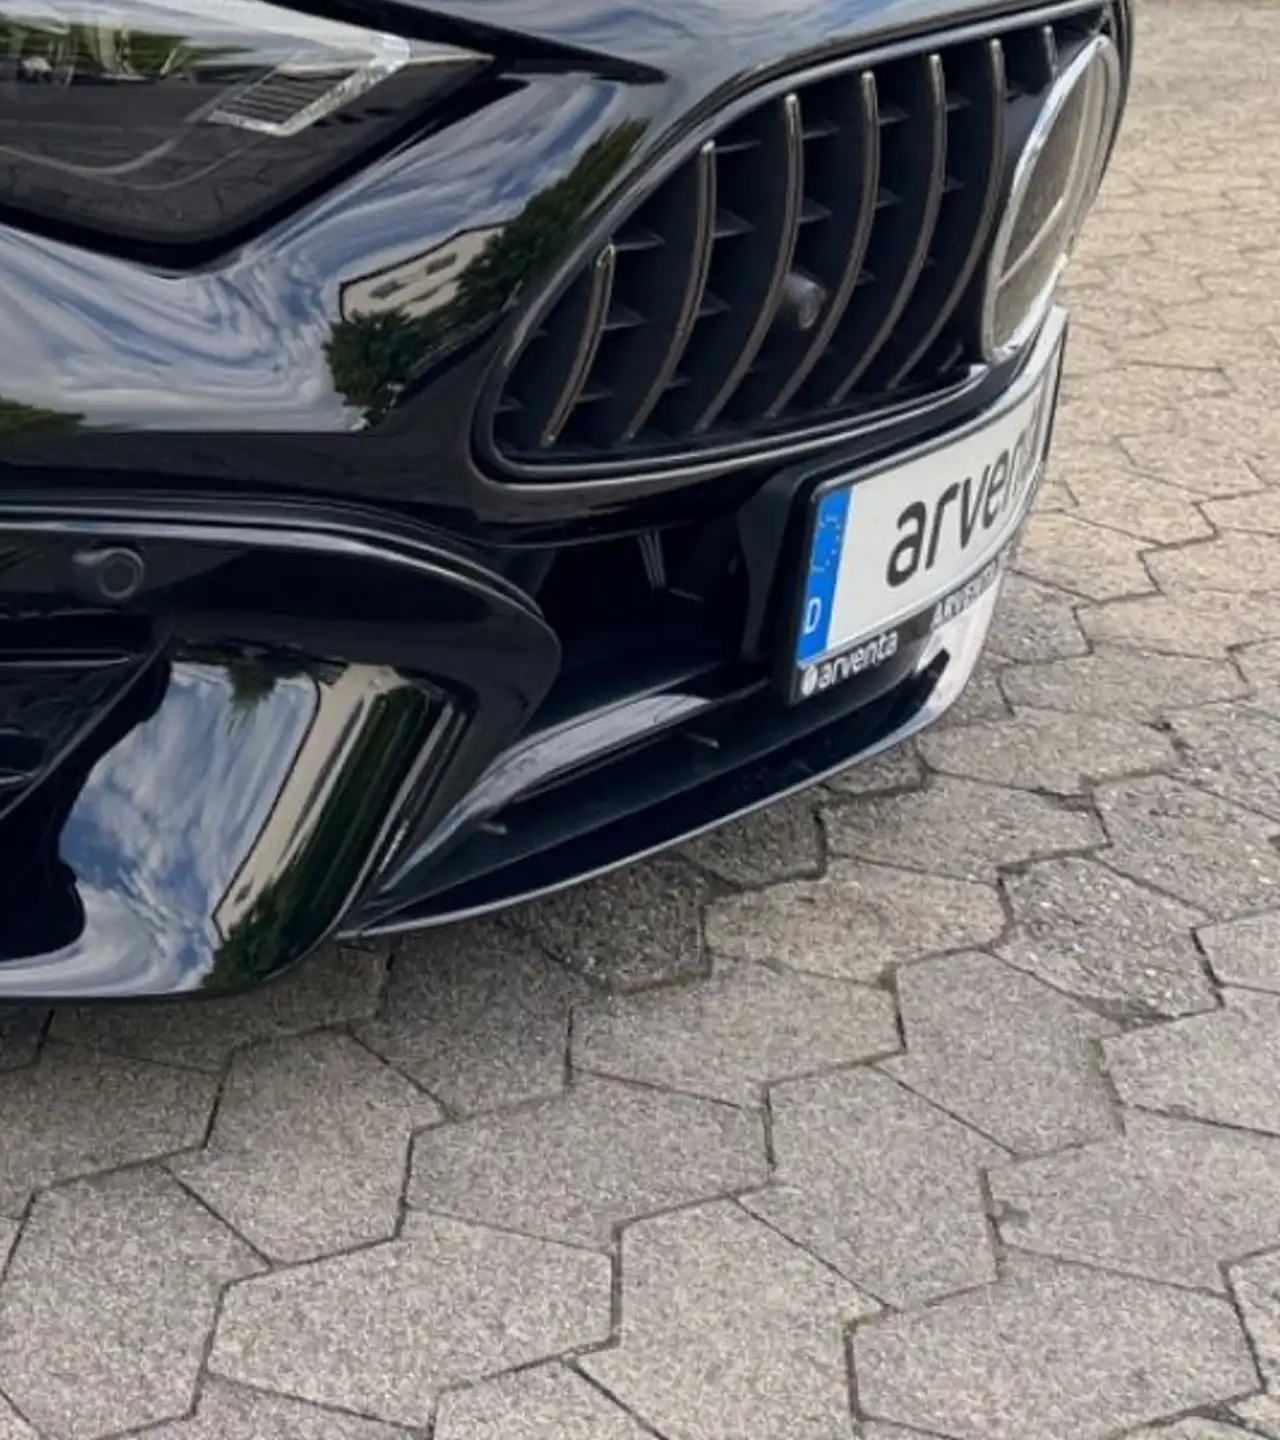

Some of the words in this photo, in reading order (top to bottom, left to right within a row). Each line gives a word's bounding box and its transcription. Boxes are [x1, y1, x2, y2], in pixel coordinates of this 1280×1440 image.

[886, 412, 1034, 587] arven
[804, 597, 822, 635] D
[818, 630, 899, 689] arventa
